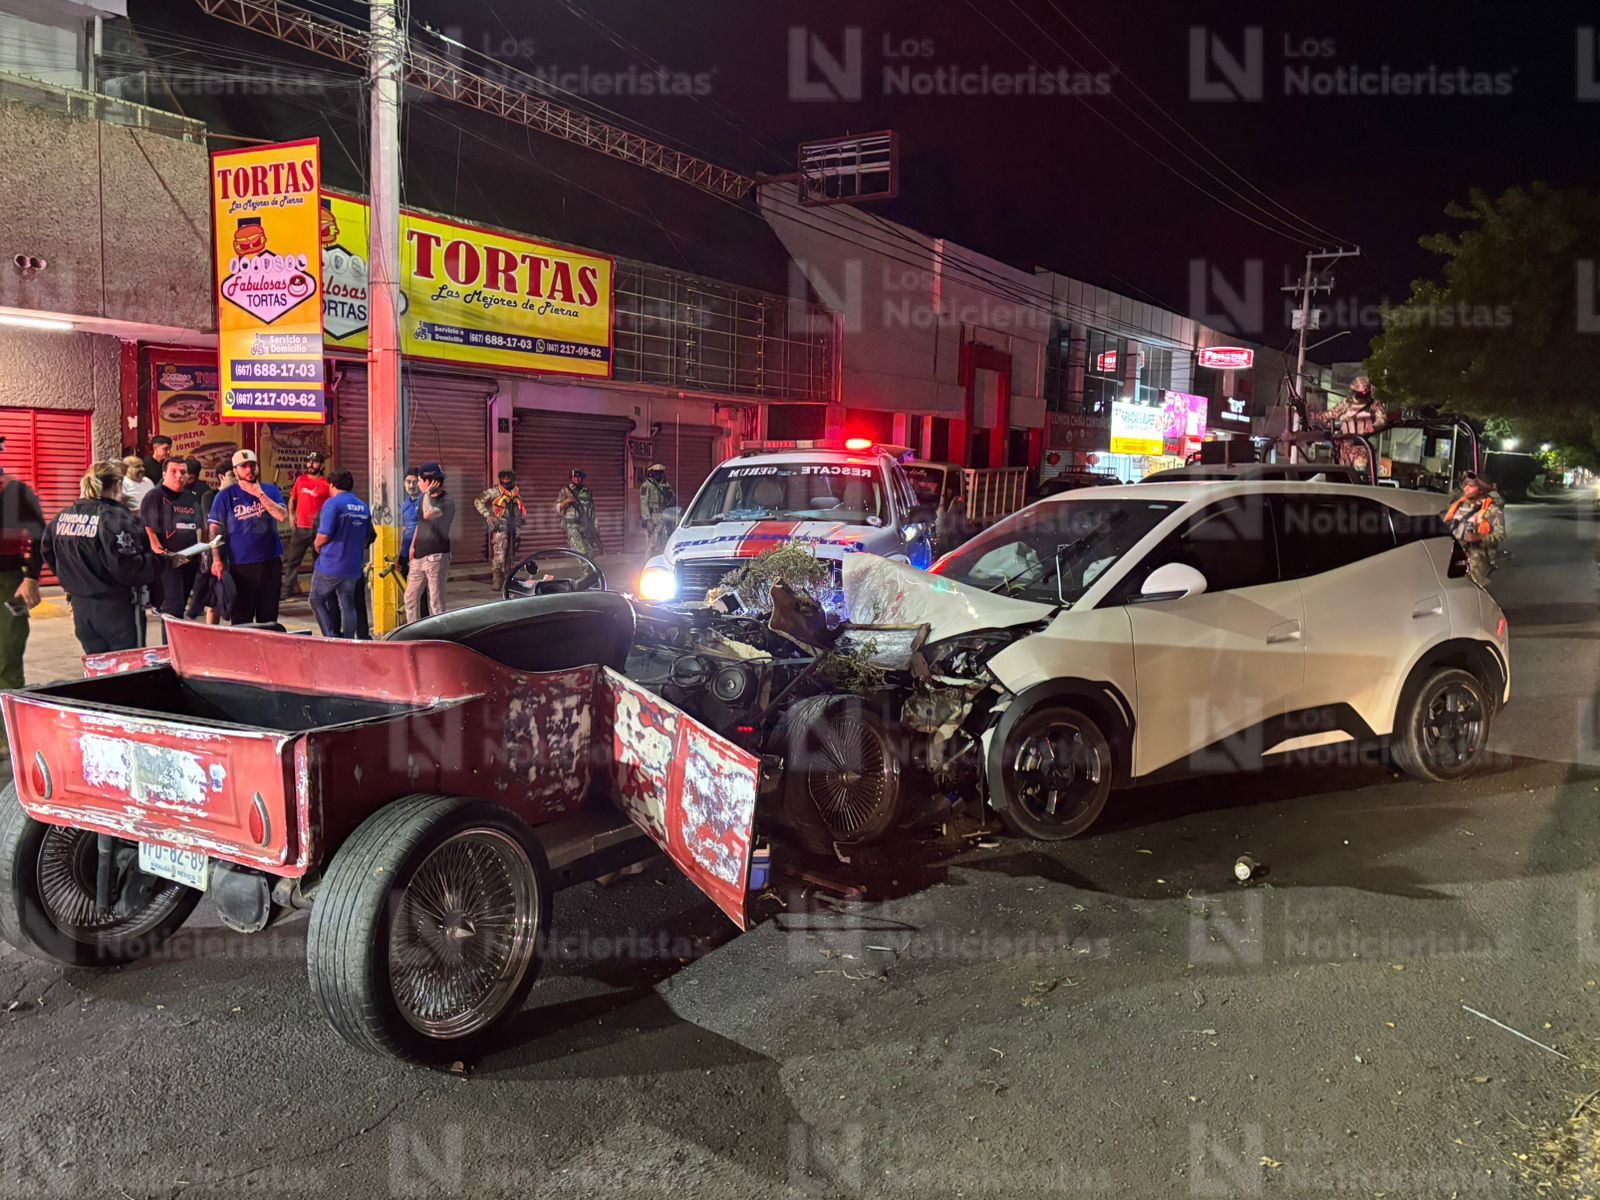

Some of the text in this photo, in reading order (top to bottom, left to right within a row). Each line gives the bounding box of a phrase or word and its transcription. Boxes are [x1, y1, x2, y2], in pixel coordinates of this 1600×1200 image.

[217, 160, 315, 200] TORTAS
[228, 200, 242, 213] Las
[243, 198, 270, 211] Mejores
[271, 197, 278, 206] de
[407, 229, 599, 307] TORTAS
[227, 275, 287, 297] Fabulosas
[323, 275, 367, 300] losas
[247, 293, 288, 307] TORTAS
[431, 284, 579, 318] Las Mejores de Pierna
[322, 300, 367, 321] ORTAS
[434, 325, 459, 335] Servicio
[269, 335, 301, 344] Servicio
[434, 334, 463, 343] Domicilio
[469, 332, 532, 350] (667) 688-17-03
[270, 344, 307, 353] Domicilio
[560, 344, 602, 358] 217-09-62
[235, 363, 316, 378] (667) 688-17-03
[236, 392, 316, 407] (667) 217-09-62
[175, 441, 200, 451] JUMBO
[174, 505, 195, 514] HUGO
[233, 501, 262, 518] Dodg
[58, 512, 89, 524] UNIDAD
[56, 522, 98, 538] VIALIDAD
